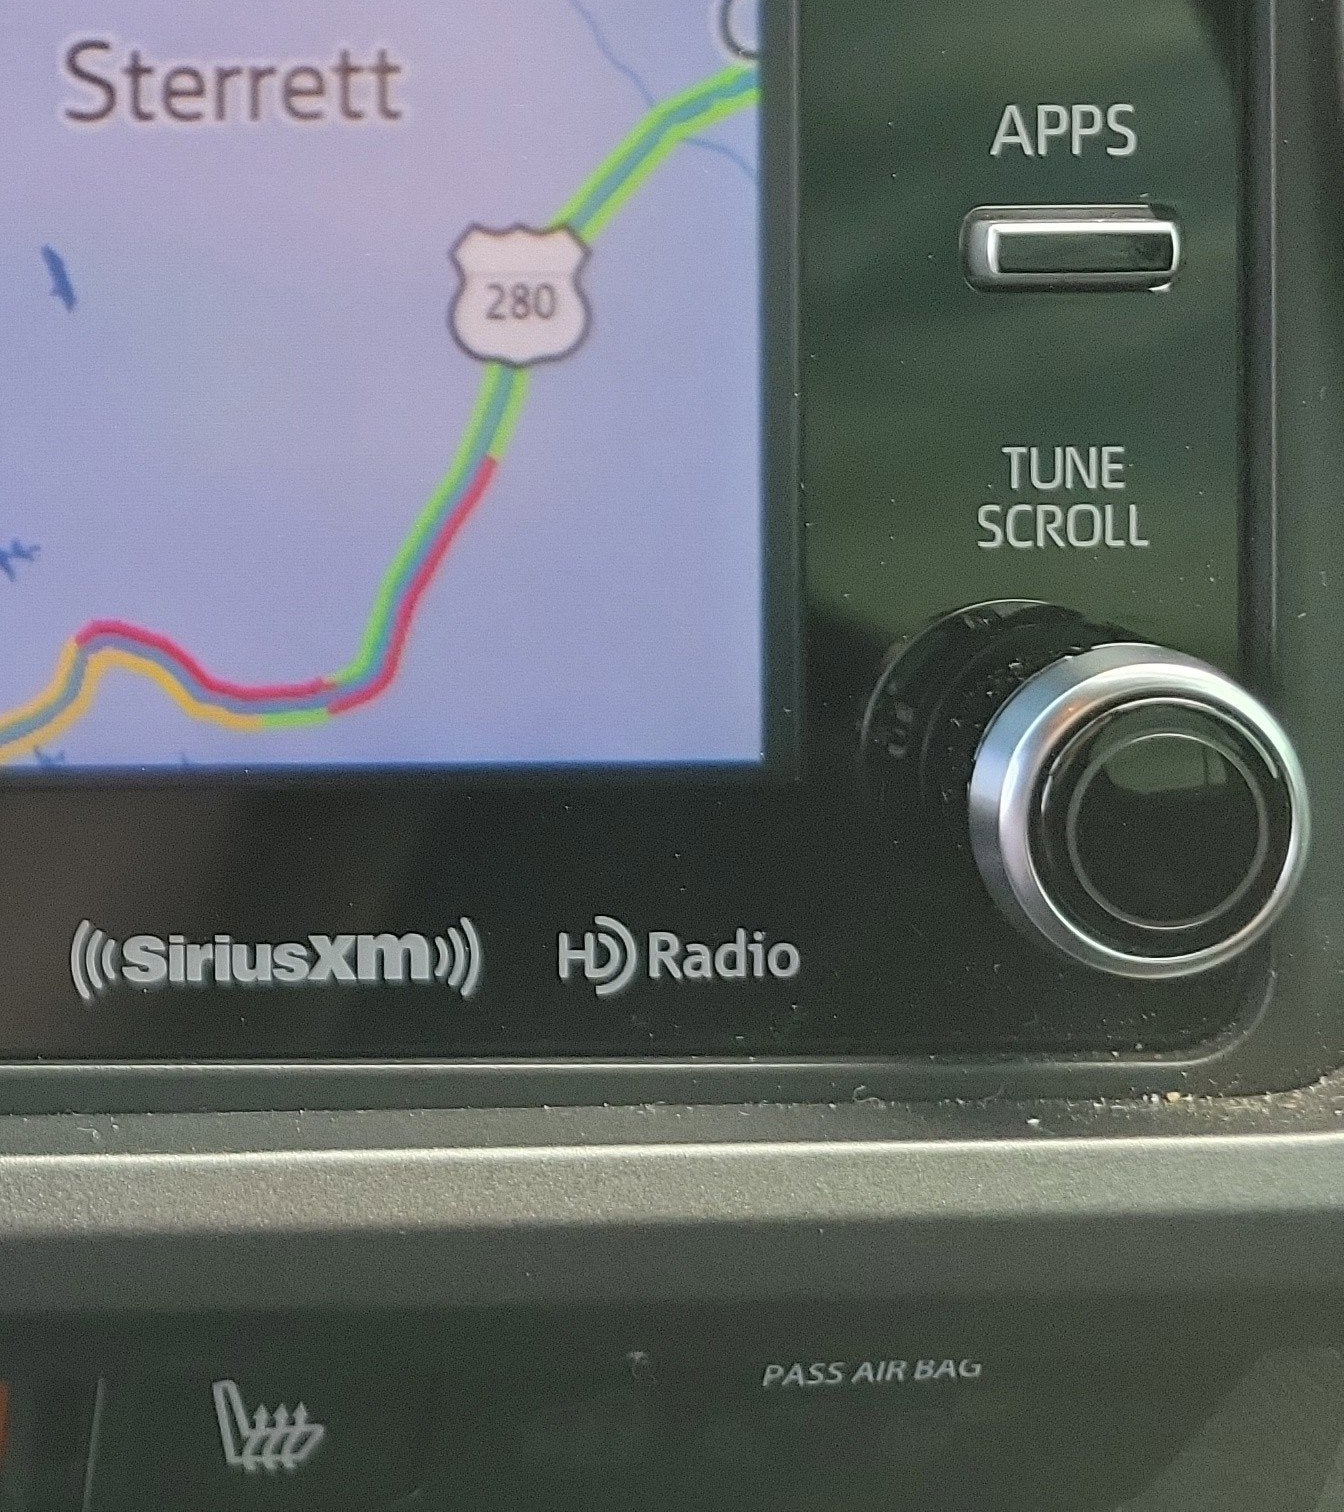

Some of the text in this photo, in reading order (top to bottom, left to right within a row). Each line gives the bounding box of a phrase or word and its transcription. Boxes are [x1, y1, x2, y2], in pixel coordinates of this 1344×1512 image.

[62, 38, 404, 124] Sterrett
[988, 102, 1138, 158] APPS
[484, 282, 558, 322] 280
[1002, 445, 1127, 492] TUNE
[976, 503, 1149, 549] SCROLL
[648, 929, 802, 980] Radio
[762, 1357, 983, 1387] PASS AIR BAG
